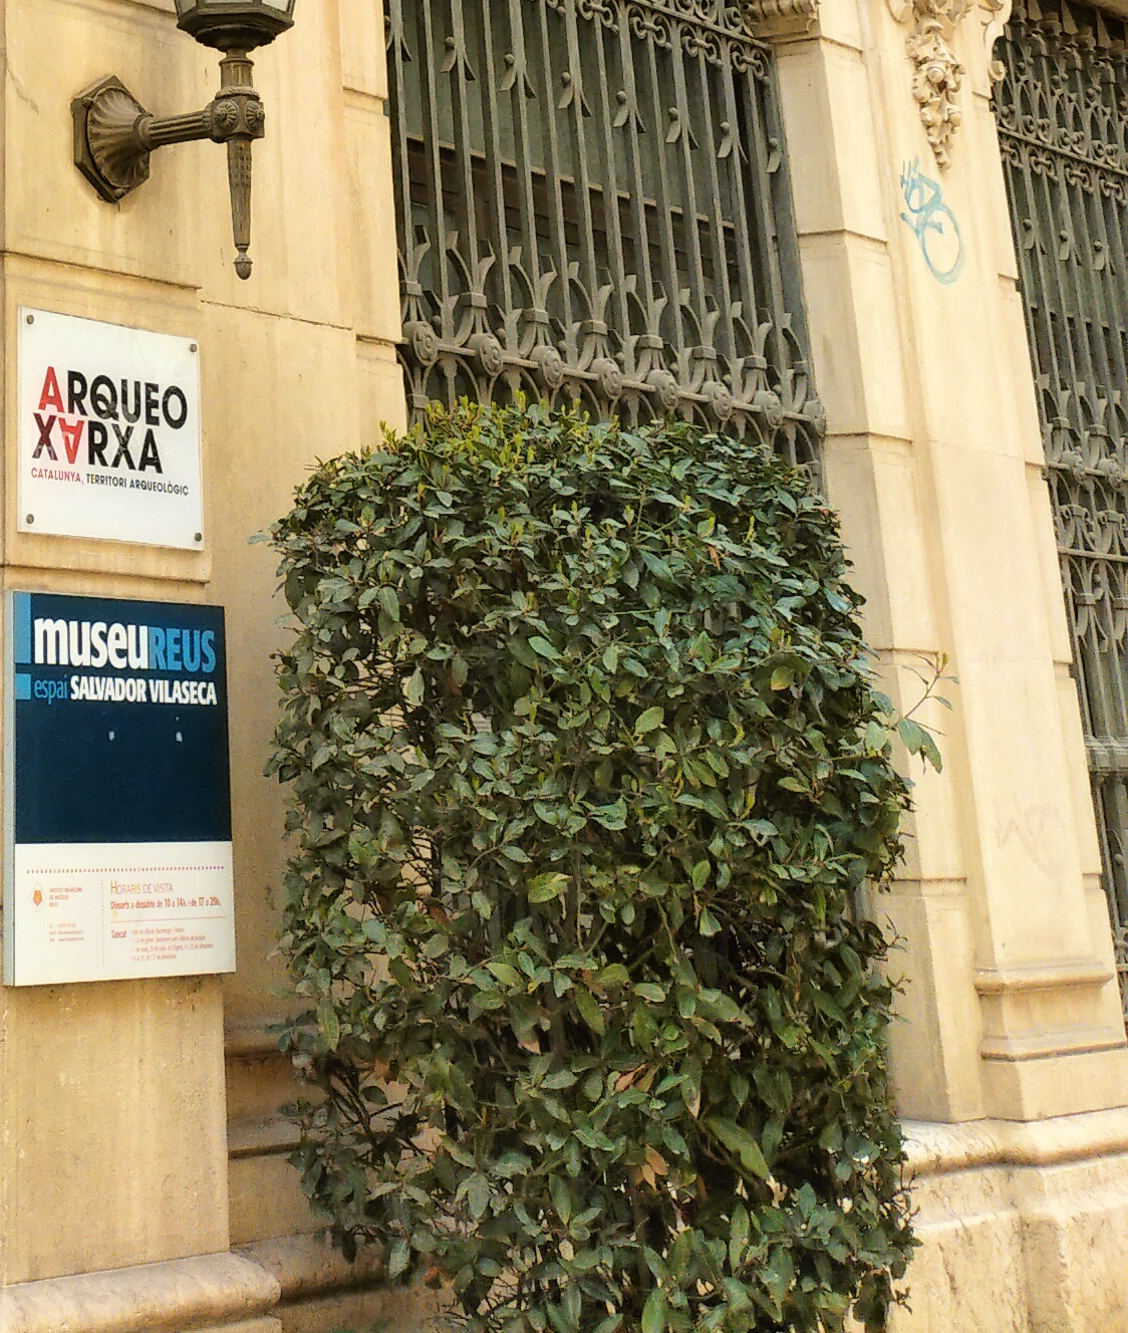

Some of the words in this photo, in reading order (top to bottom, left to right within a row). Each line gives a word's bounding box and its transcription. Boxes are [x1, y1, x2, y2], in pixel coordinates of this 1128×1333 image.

[38, 366, 188, 429] ARQUEO
[32, 412, 163, 474] XARXA
[31, 467, 84, 485] CATALUNYA,
[86, 473, 127, 488] TERRITORI
[129, 480, 189, 496] ARQUEOLÒGIC
[34, 675, 68, 704] espai
[70, 675, 147, 703] SALVADOR
[149, 678, 218, 706] VILASECA
